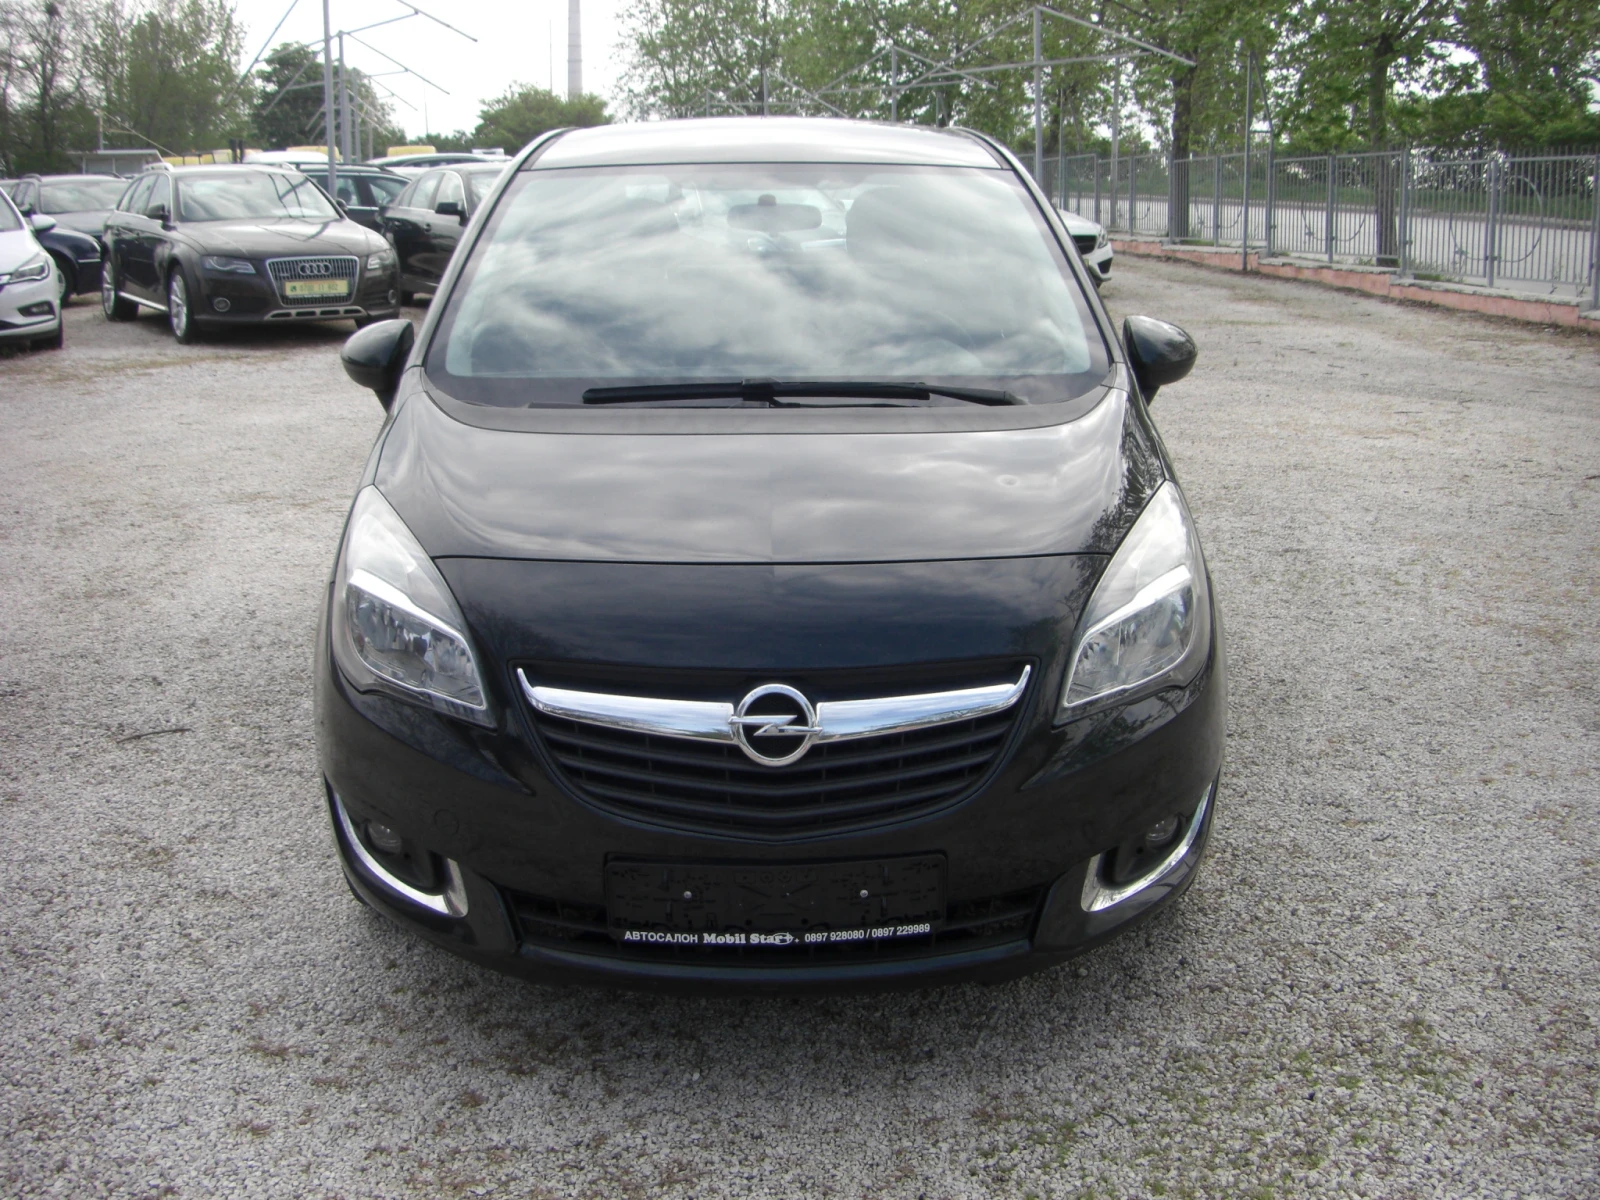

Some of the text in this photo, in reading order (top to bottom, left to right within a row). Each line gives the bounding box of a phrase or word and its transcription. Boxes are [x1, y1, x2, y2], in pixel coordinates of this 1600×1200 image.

[624, 930, 698, 943] АВТОСАЛОН
[703, 933, 746, 943] Mobil
[805, 932, 827, 942] 0897
[830, 929, 864, 940] 928080
[872, 927, 895, 937] 0897
[897, 923, 930, 935] 229989
